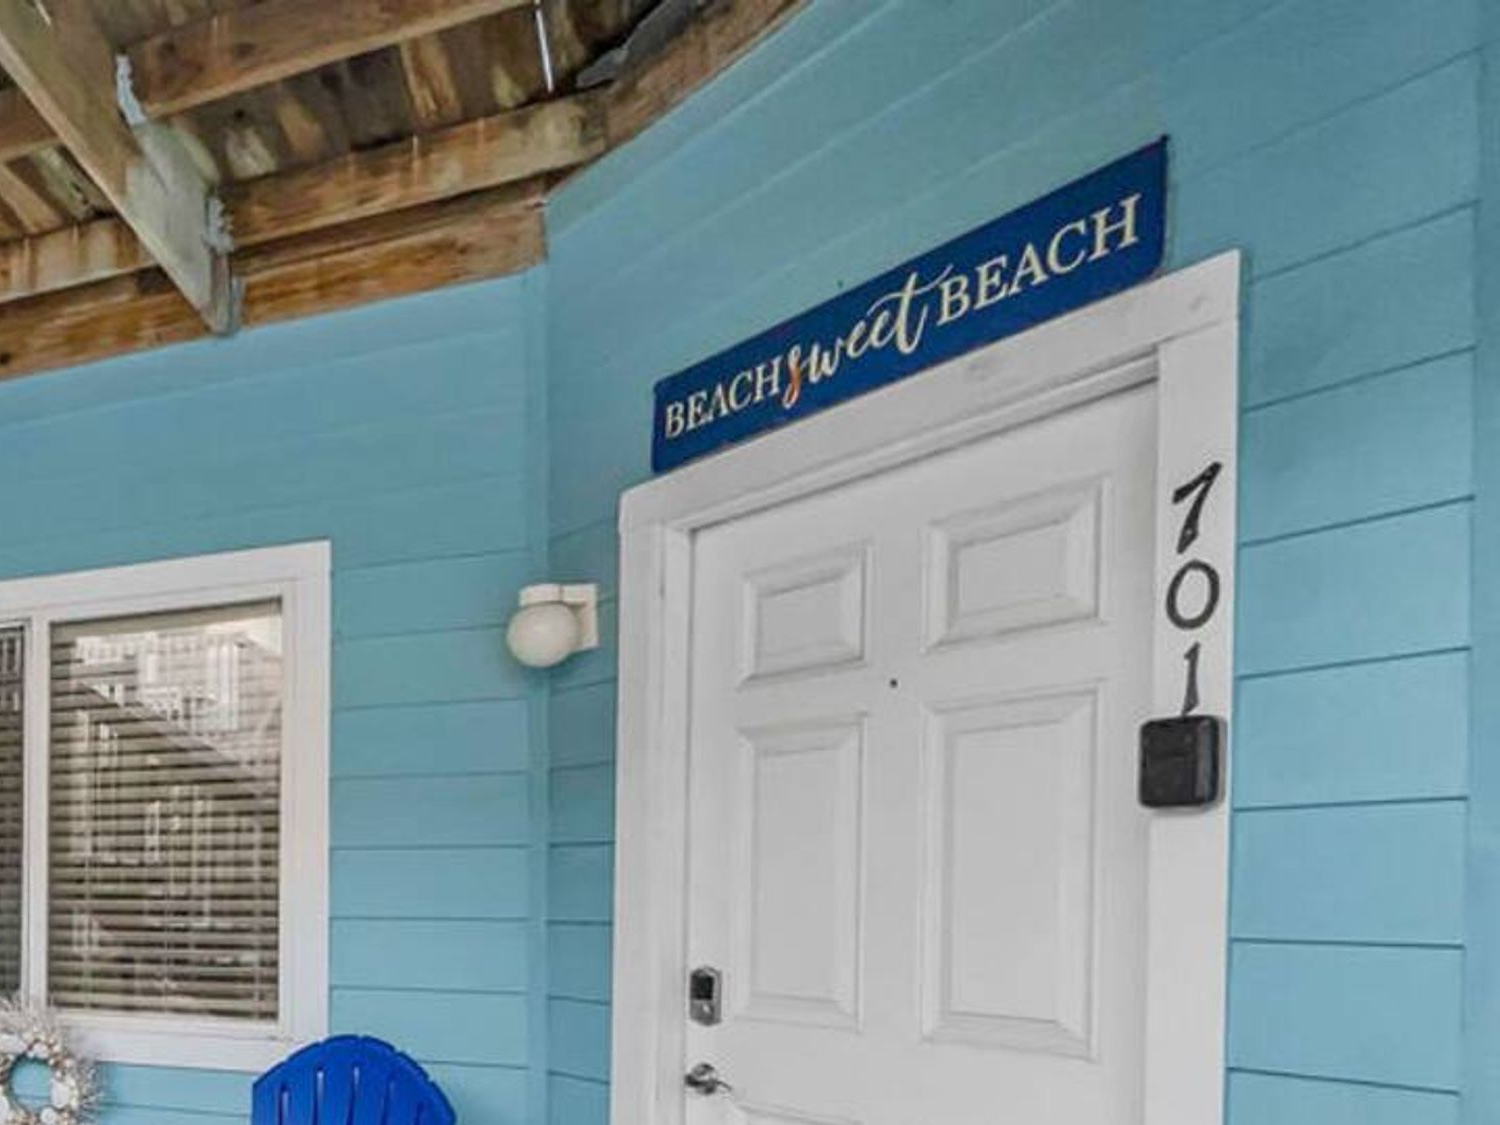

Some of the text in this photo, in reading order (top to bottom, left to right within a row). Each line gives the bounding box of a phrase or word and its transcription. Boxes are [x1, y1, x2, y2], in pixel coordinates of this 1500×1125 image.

[665, 193, 1142, 438] BEACH sweet BEACH
[1165, 461, 1223, 715] 701
